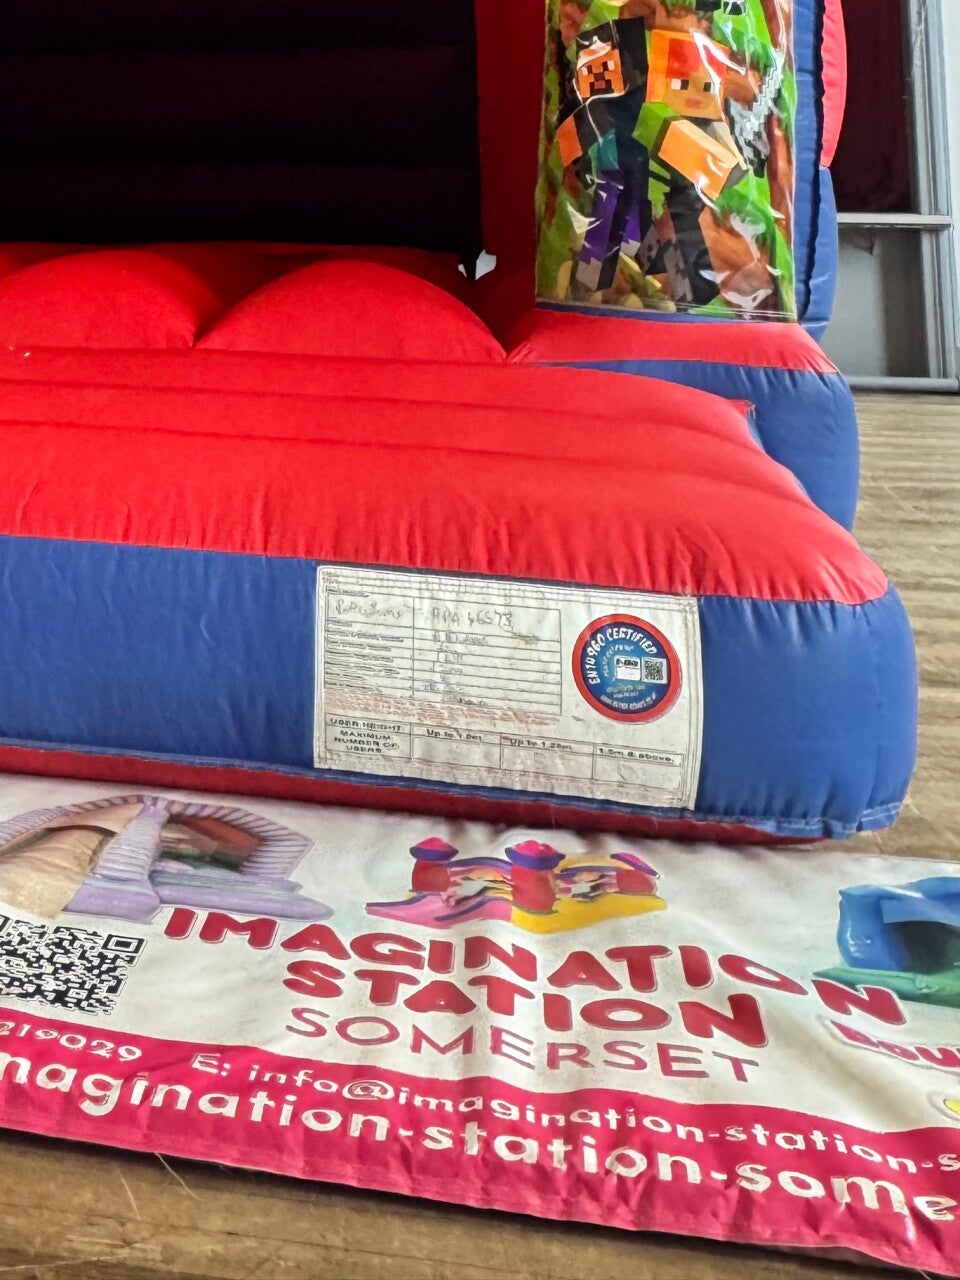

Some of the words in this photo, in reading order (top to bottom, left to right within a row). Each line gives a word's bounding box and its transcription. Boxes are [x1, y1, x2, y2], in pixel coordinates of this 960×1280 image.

[606, 627, 658, 655] CERTIFIED
[164, 907, 907, 1026] IMAGINATION
[283, 959, 768, 1048] STATION
[191, 1052, 231, 1077] E:
[286, 1007, 760, 1083] SOMERSET
